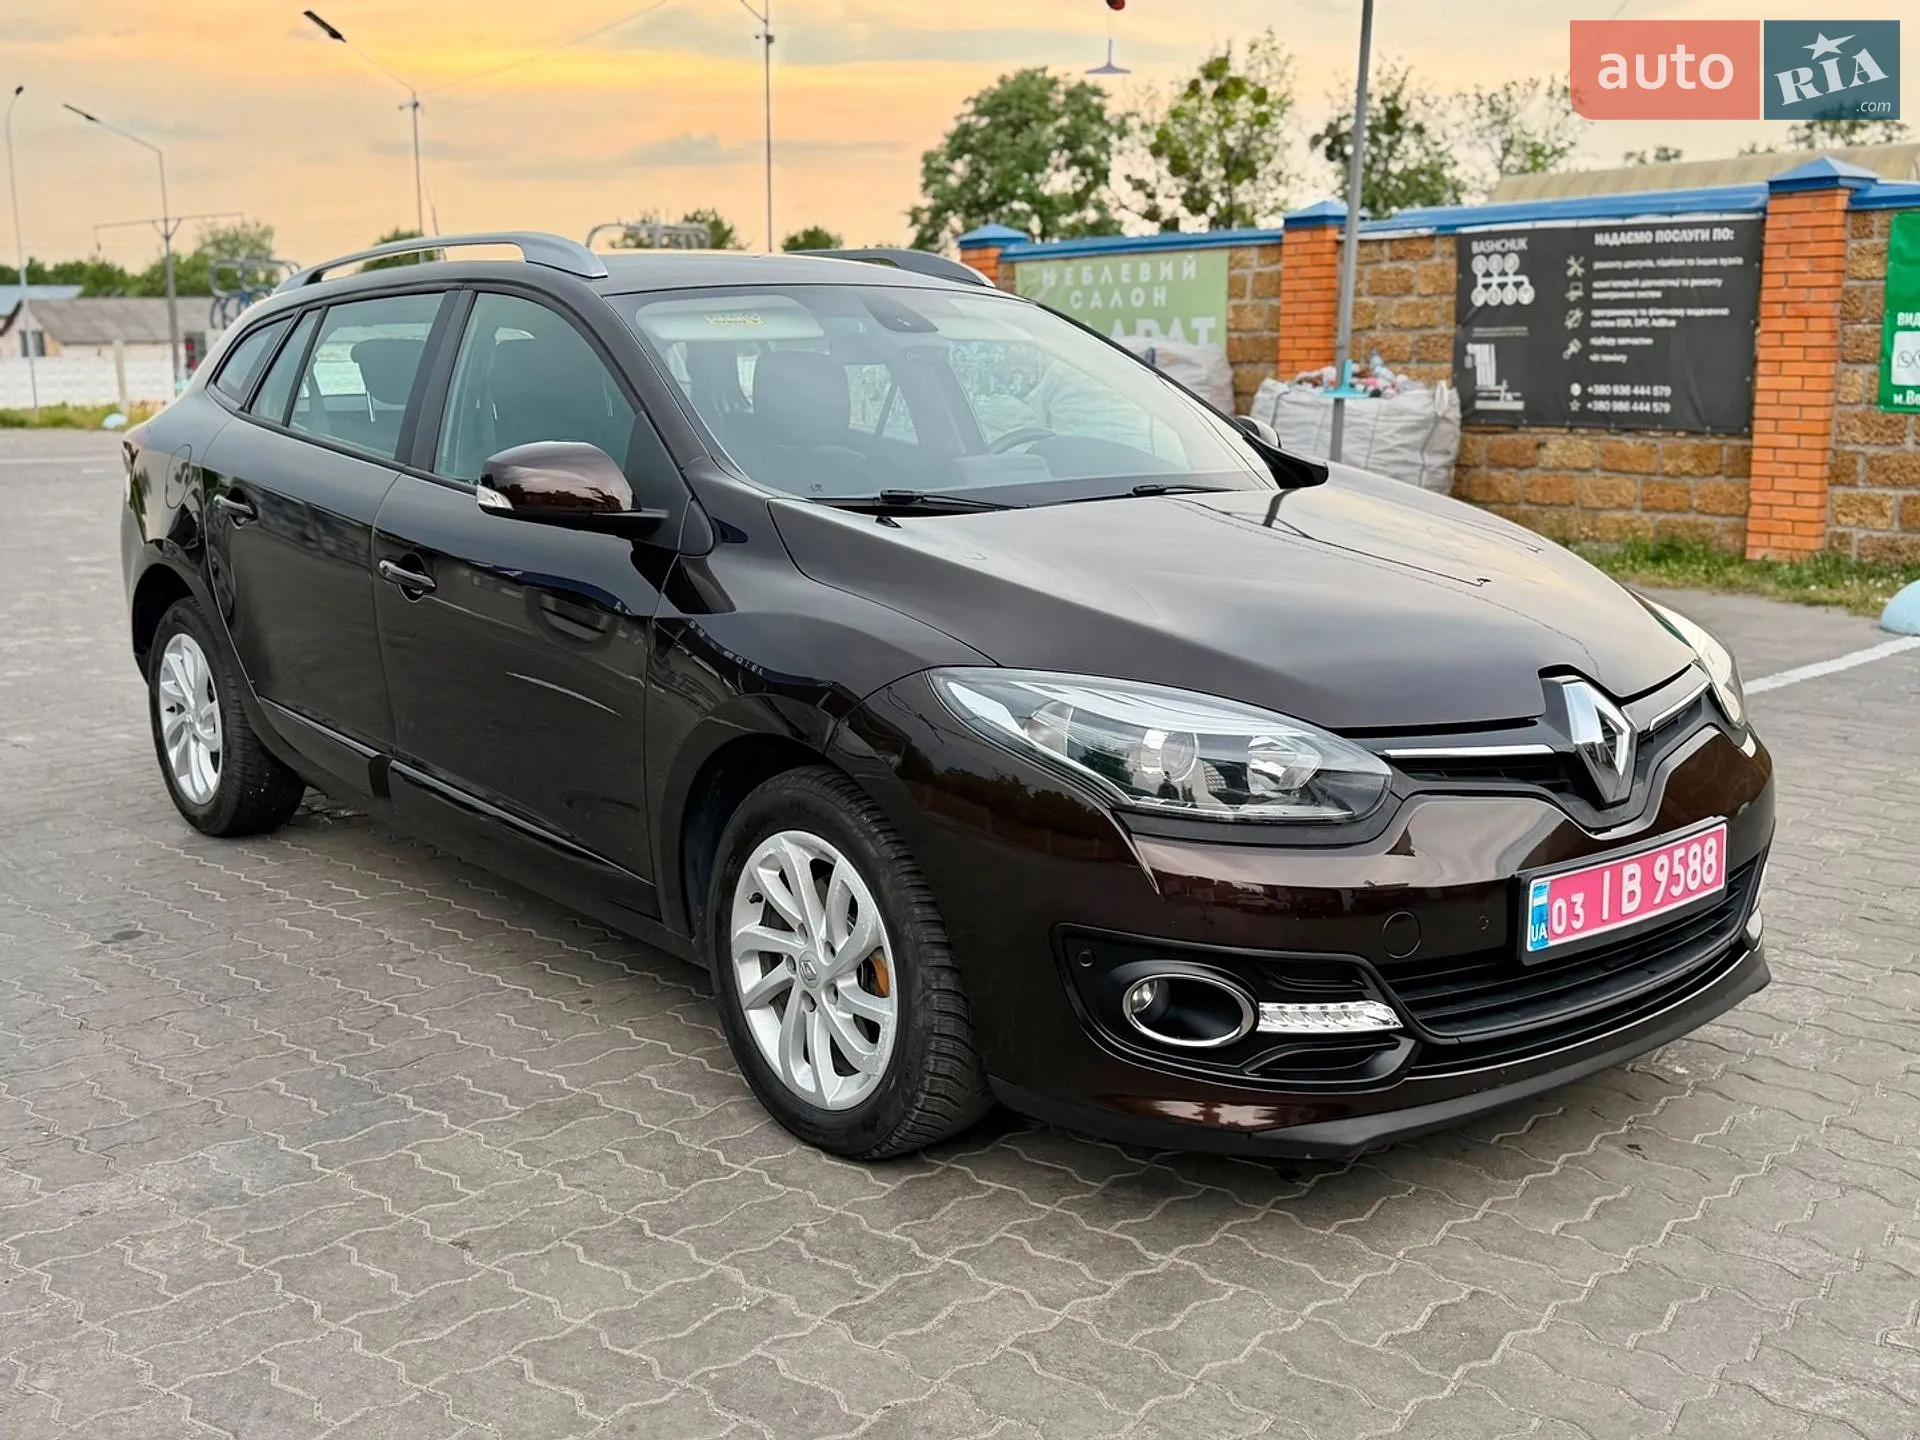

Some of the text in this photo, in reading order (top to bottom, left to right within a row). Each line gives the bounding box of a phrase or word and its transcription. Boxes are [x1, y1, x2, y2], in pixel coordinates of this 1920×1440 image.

[1655, 228, 1711, 244] ПОСЛУГИ
[1712, 227, 1735, 241] ПО:
[1069, 286, 1167, 310] САЛОН
[1632, 385, 1651, 397] 444
[1551, 892, 1585, 935] 03
[1653, 837, 1718, 905] 9588
[1531, 923, 1548, 942] UA
